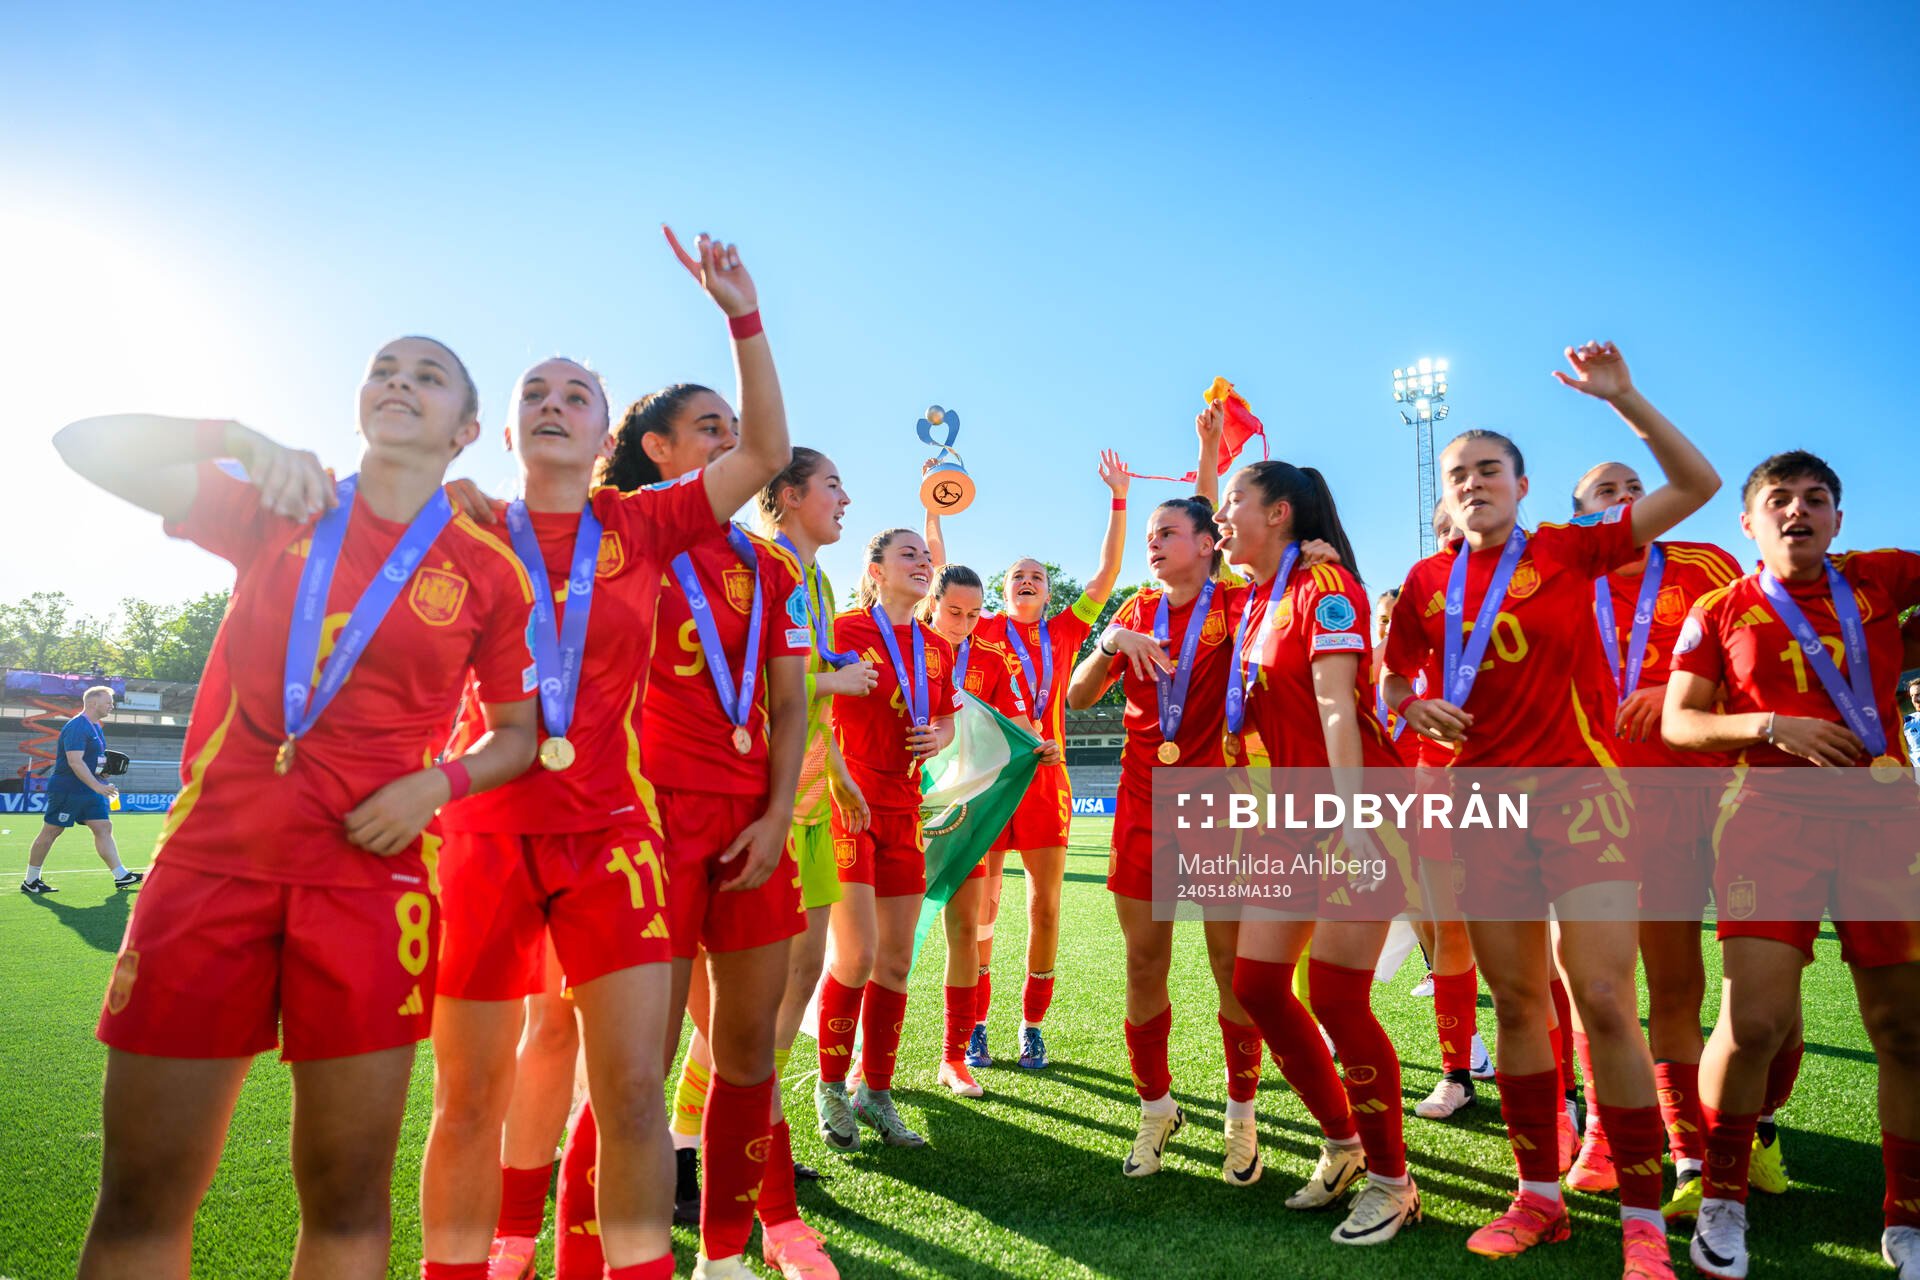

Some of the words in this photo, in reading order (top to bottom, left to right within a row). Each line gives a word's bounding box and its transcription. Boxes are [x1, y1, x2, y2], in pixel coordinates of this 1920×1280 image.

[678, 618, 706, 676] 9
[127, 794, 176, 804] amazo
[1058, 789, 1069, 823] 5
[1072, 798, 1104, 812] VISA
[1562, 791, 1631, 844] 20
[606, 839, 666, 909] 11
[394, 891, 431, 976] 8
